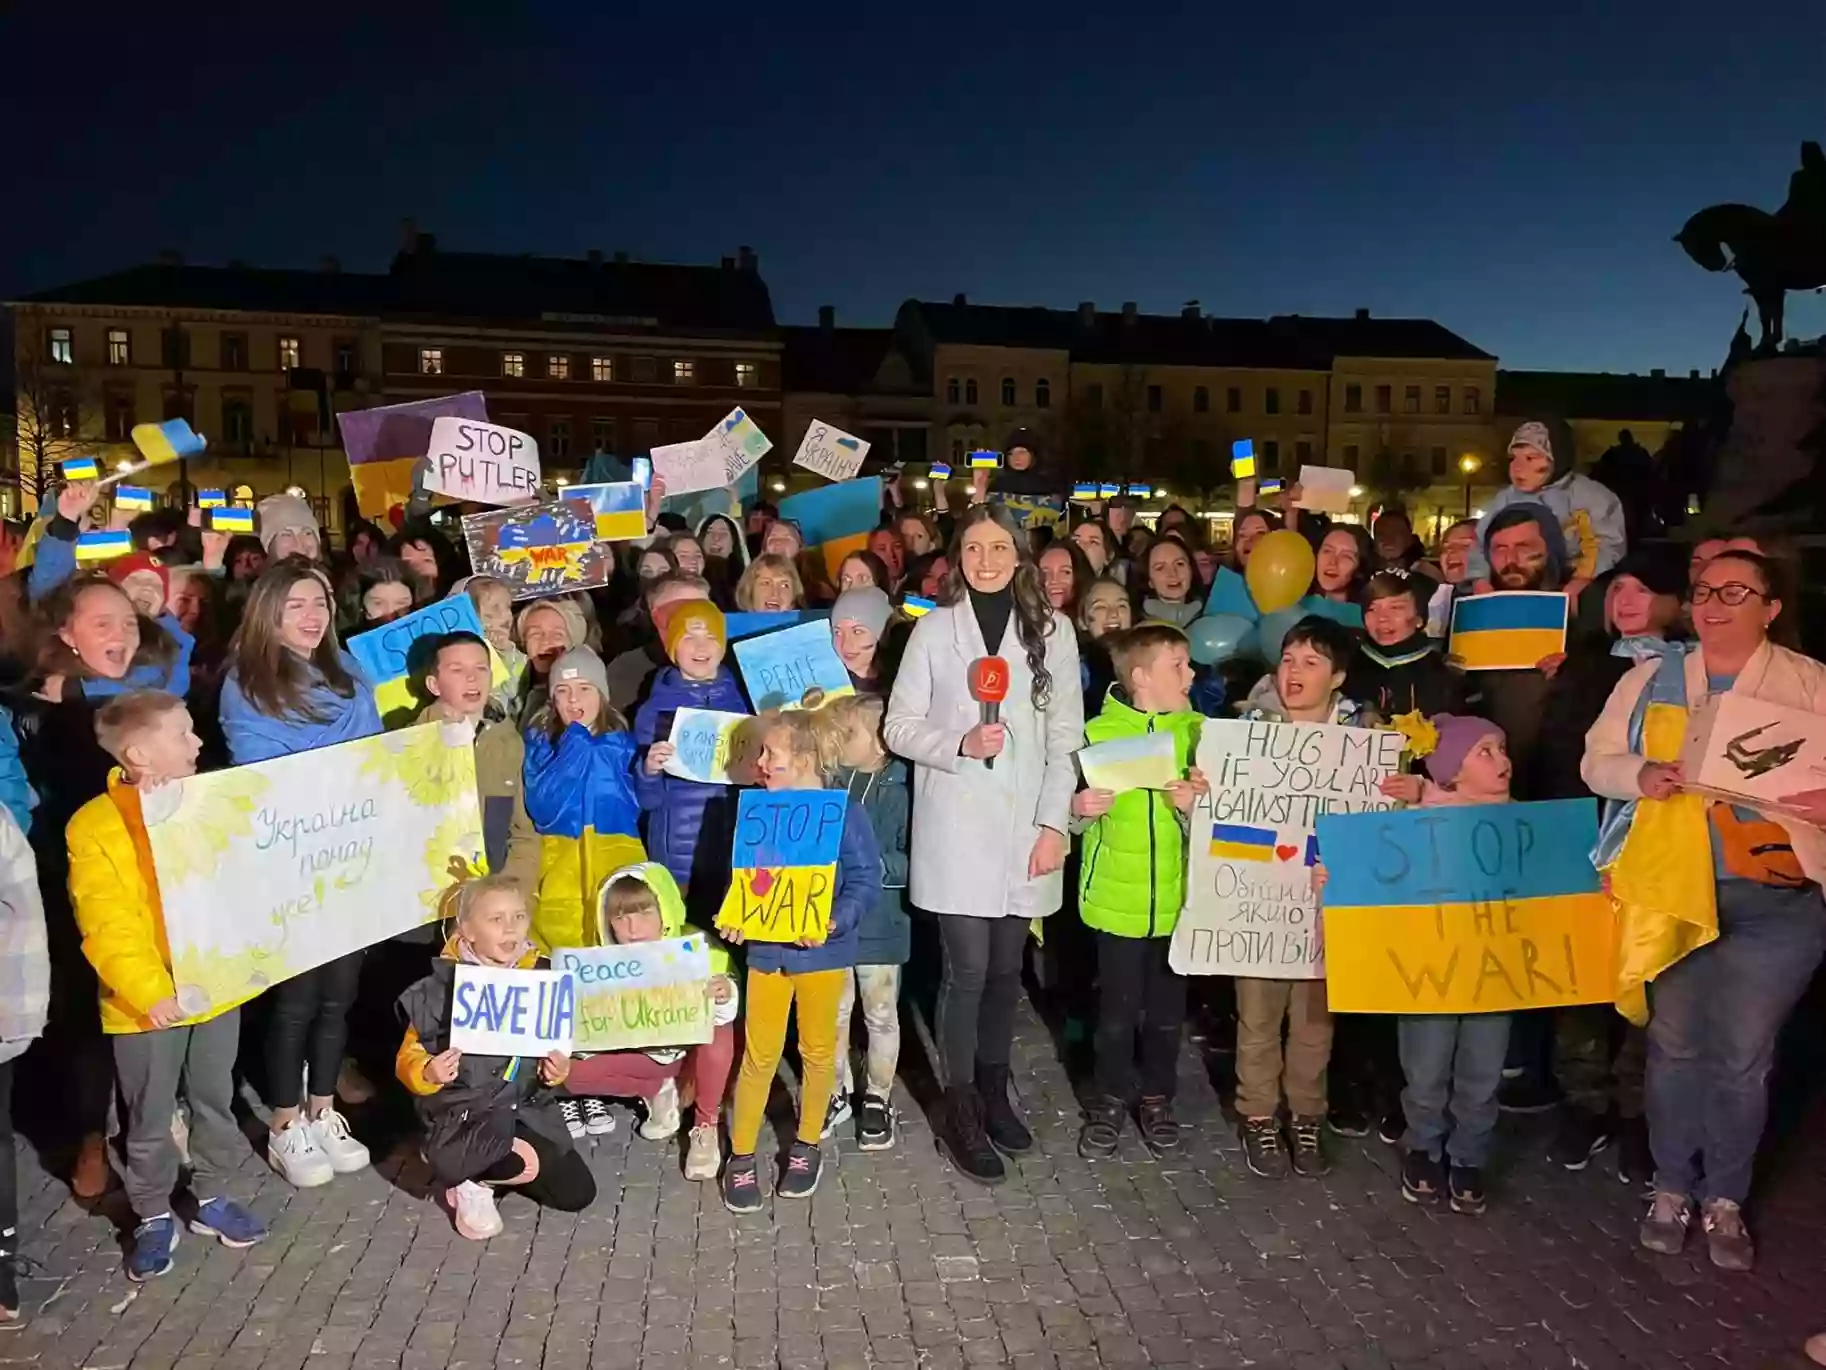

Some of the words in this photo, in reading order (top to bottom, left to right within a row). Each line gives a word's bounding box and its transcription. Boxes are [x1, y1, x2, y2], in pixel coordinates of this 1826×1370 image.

[456, 425, 523, 460] STOP
[439, 453, 537, 494] PUTLER
[530, 547, 568, 564] WAR
[1246, 722, 1324, 766] HUG
[1340, 733, 1400, 767] ME
[1262, 761, 1342, 792] YOU
[256, 798, 377, 859] Україна
[744, 802, 843, 846] STOP
[1372, 818, 1534, 885] STOP
[740, 872, 822, 933] WAR
[1416, 888, 1522, 941] THE
[1190, 928, 1274, 964] ПРОТИ
[563, 953, 643, 984] Peace
[1385, 934, 1578, 1004] WAR!
[453, 981, 530, 1036] SAVE
[535, 974, 574, 1041] UA
[579, 1003, 614, 1042] for
